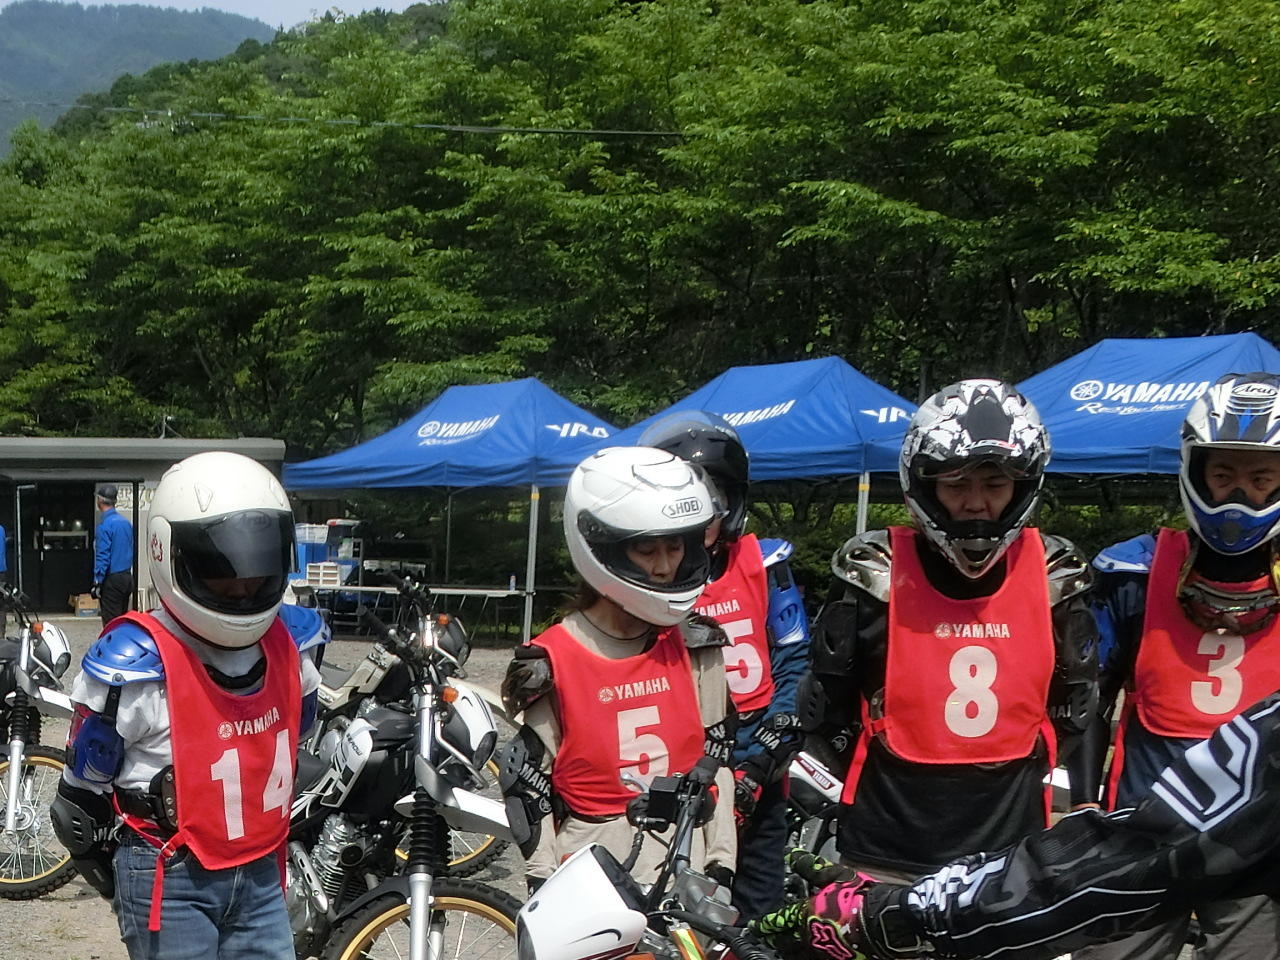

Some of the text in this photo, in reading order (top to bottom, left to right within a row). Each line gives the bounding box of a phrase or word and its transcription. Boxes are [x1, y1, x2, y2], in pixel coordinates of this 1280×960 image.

[1102, 381, 1210, 404] YAMAHA
[1239, 384, 1272, 396] Arai
[437, 414, 500, 438] YAMAHA
[669, 500, 700, 516] SHOEI
[953, 623, 1010, 638] YAMAHA
[1190, 631, 1246, 715] 3
[614, 676, 670, 701] YAMAHA
[944, 645, 999, 738] 8
[233, 706, 280, 737] YAMAHA
[617, 705, 669, 787] 5
[210, 728, 293, 841] 14
